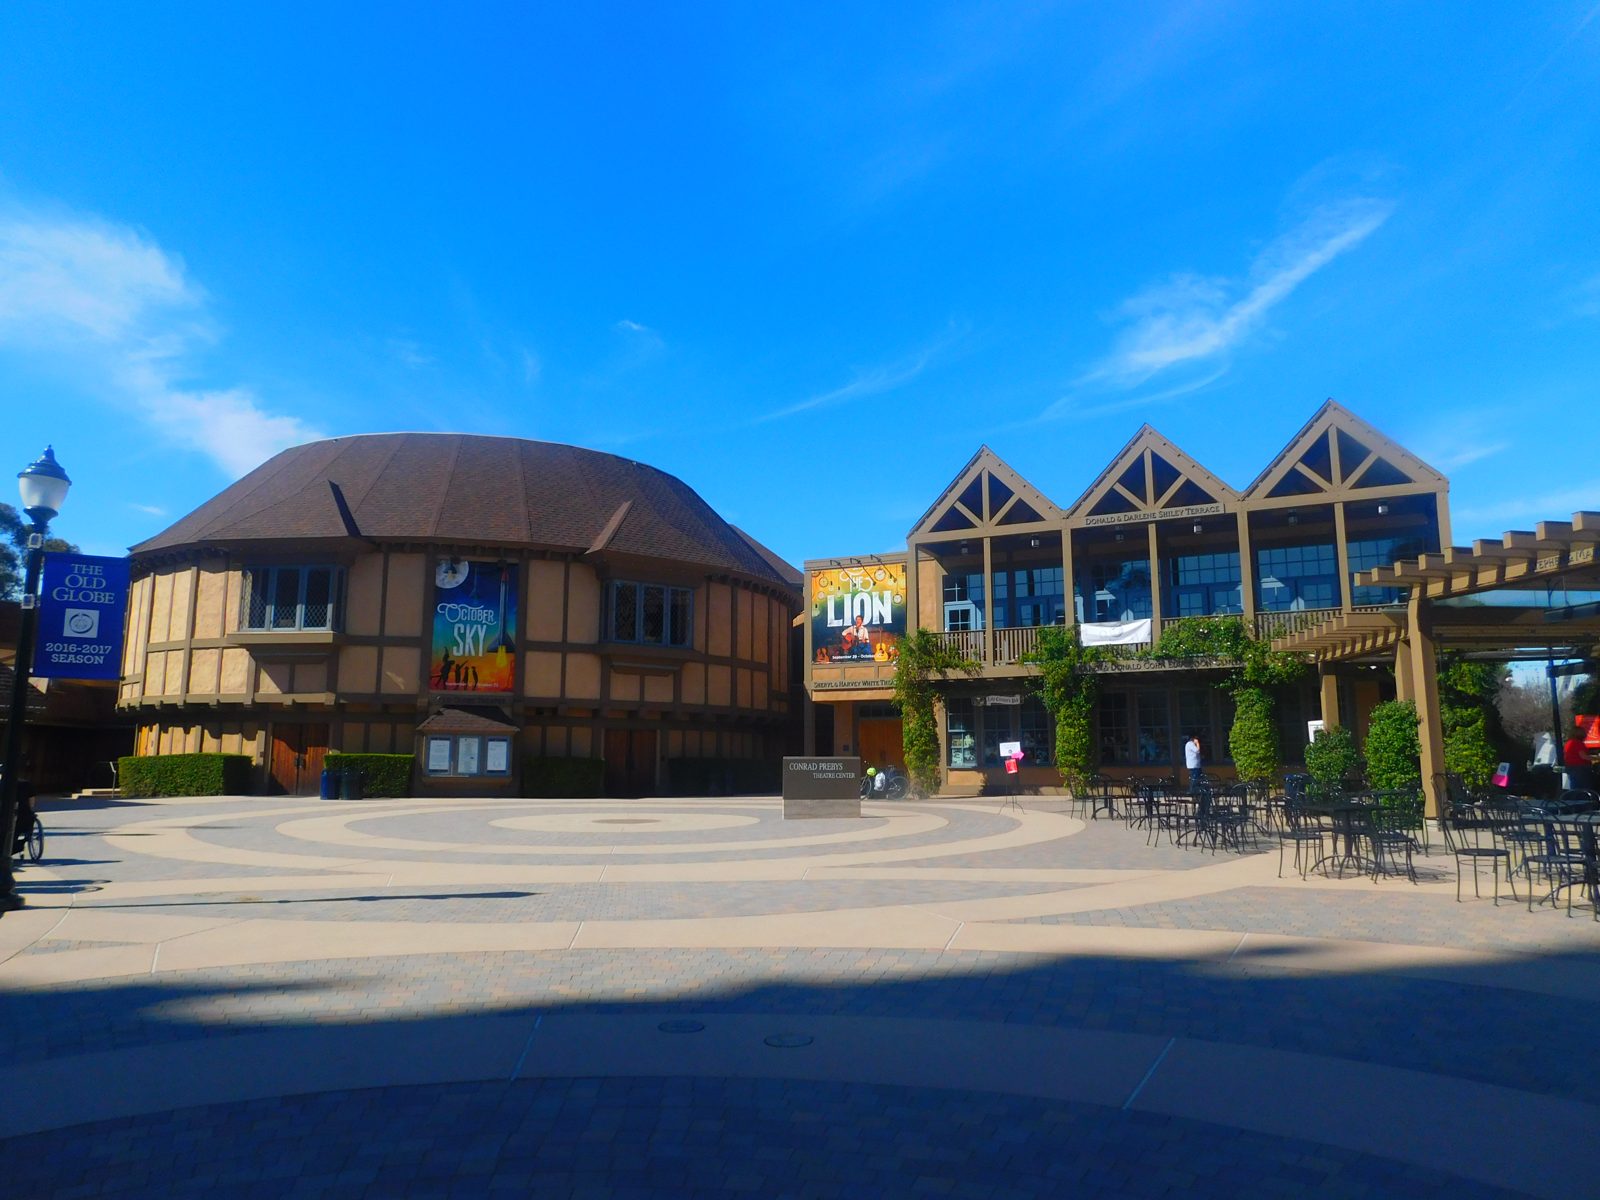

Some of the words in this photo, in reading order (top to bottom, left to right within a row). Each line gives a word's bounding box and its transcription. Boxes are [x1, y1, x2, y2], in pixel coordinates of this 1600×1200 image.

[1085, 517, 1116, 526] DONALD
[1124, 512, 1157, 522] DARLENE
[1159, 509, 1184, 518] SHILEY
[1185, 506, 1220, 516] TERRACE
[71, 563, 104, 576] THE
[65, 574, 107, 590] OLD
[52, 587, 115, 604] GLOBE
[437, 603, 497, 625] OCTOBER
[827, 590, 893, 627] LION
[453, 623, 487, 656] SKY
[45, 643, 112, 654] 2016-2017
[51, 653, 105, 664] SEASON
[1111, 663, 1142, 671] DONALD
[1143, 661, 1165, 670] COHN
[789, 762, 818, 771] CONRAD
[819, 762, 843, 771] PREBYS
